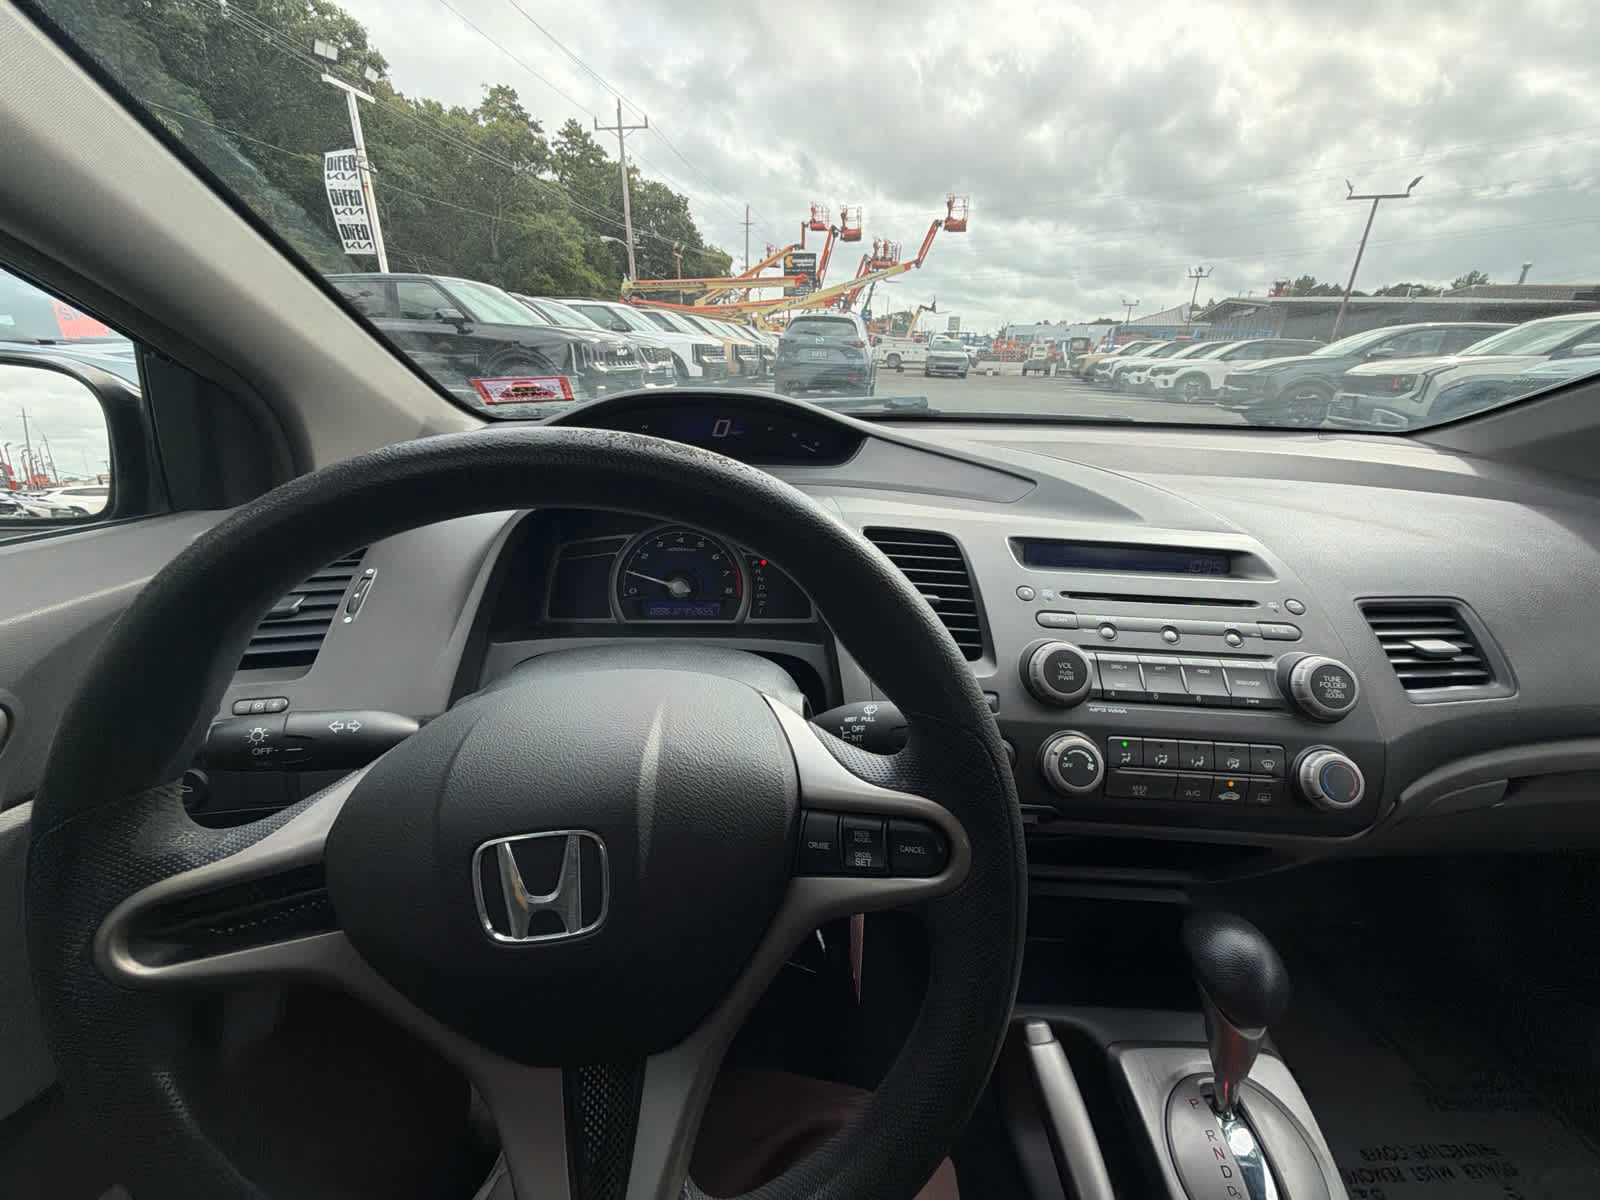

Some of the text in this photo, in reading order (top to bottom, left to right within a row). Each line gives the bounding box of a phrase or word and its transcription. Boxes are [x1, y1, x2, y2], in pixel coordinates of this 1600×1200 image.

[711, 418, 731, 438] 0
[1319, 681, 1347, 689] FOLDER
[851, 725, 866, 733] OFF
[251, 747, 274, 756] OFF
[807, 841, 831, 850] CRUISE
[900, 845, 927, 855] CANCEL
[855, 858, 872, 867] SET
[1187, 1097, 1200, 1110] P
[1205, 1129, 1218, 1142] R
[1212, 1146, 1226, 1161] N
[1220, 1164, 1233, 1179] D
